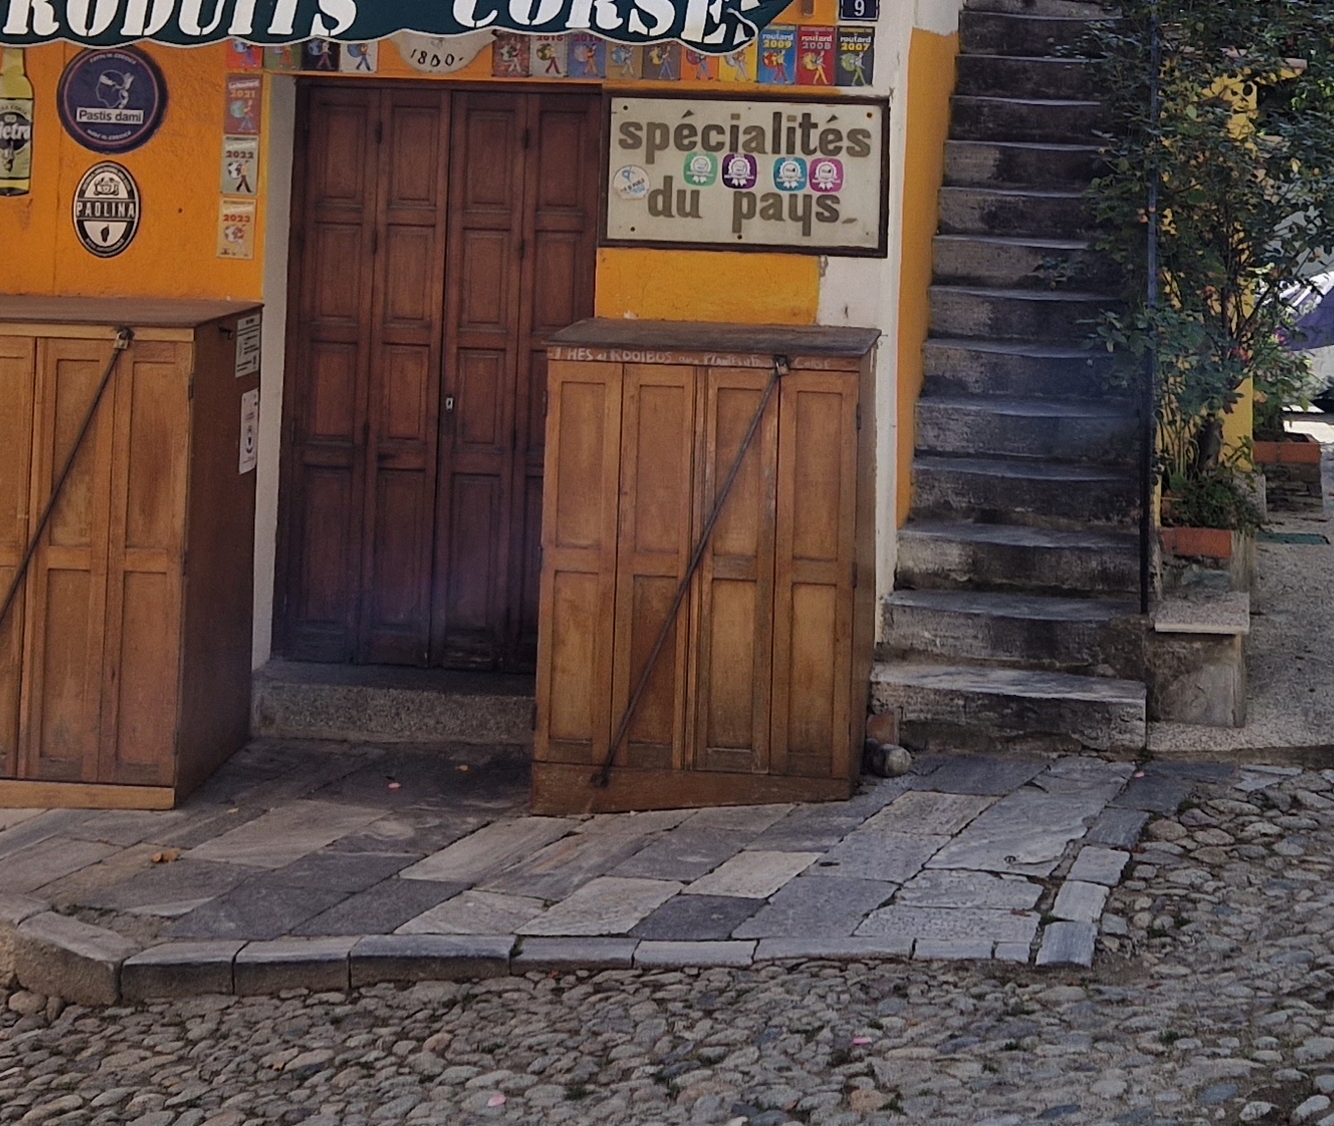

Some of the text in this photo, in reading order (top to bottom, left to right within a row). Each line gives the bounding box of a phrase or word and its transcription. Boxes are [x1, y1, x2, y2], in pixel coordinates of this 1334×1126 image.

[763, 39, 792, 49] 2009
[802, 41, 832, 50] 2008
[841, 42, 871, 51] 2007
[230, 89, 256, 98] 2021
[79, 110, 142, 122] Pastis dami
[618, 109, 872, 165] spécialités
[226, 150, 254, 159] 2022
[76, 202, 136, 217] PAOLINA
[647, 175, 703, 219] du
[731, 190, 841, 237] pays
